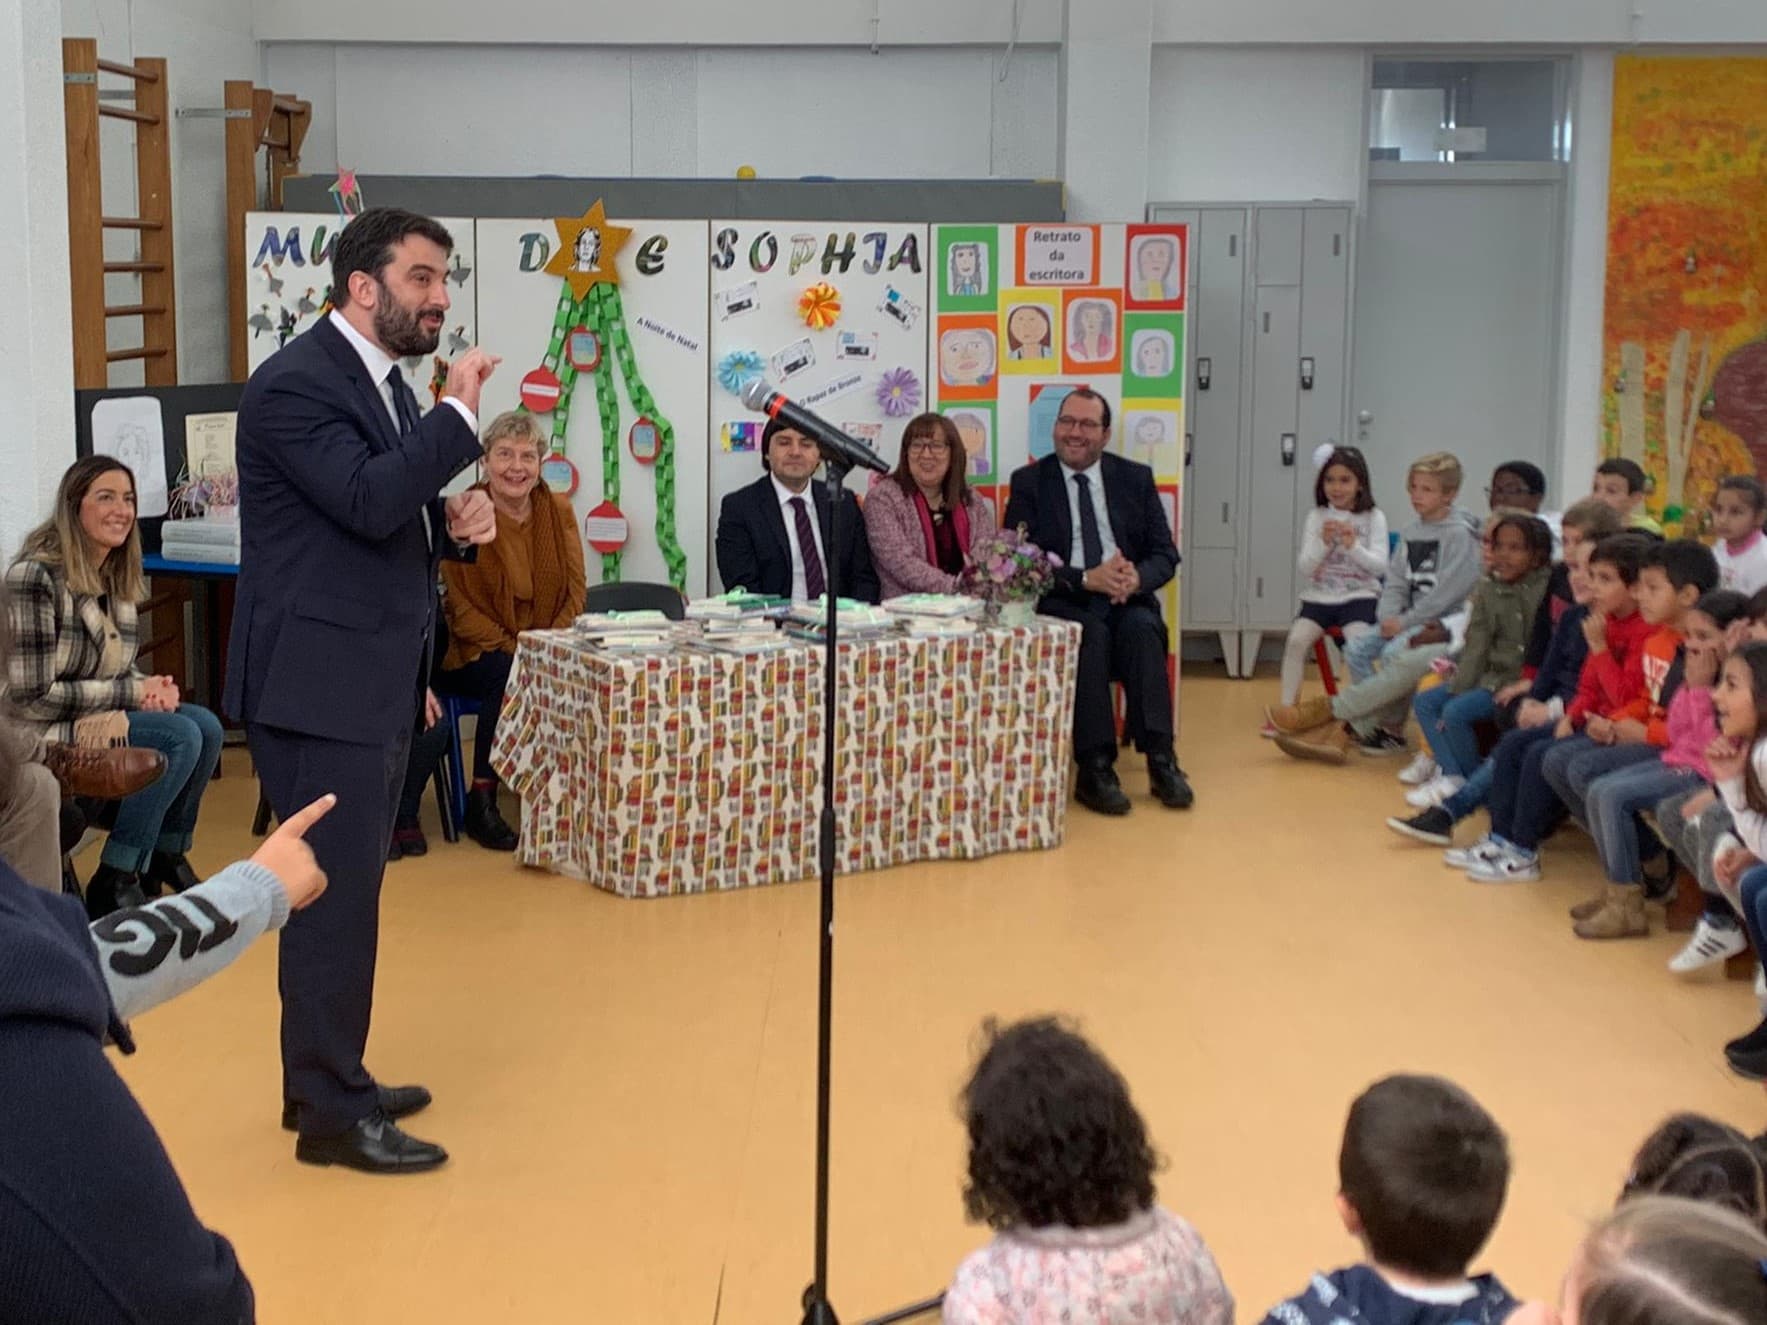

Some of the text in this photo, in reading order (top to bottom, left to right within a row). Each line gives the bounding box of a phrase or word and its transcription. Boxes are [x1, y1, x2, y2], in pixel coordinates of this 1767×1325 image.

[1033, 231, 1081, 242] Retrato
[1049, 249, 1065, 261] da
[1029, 268, 1085, 281] escritora
[637, 317, 643, 326] A
[677, 334, 698, 351] Natal
